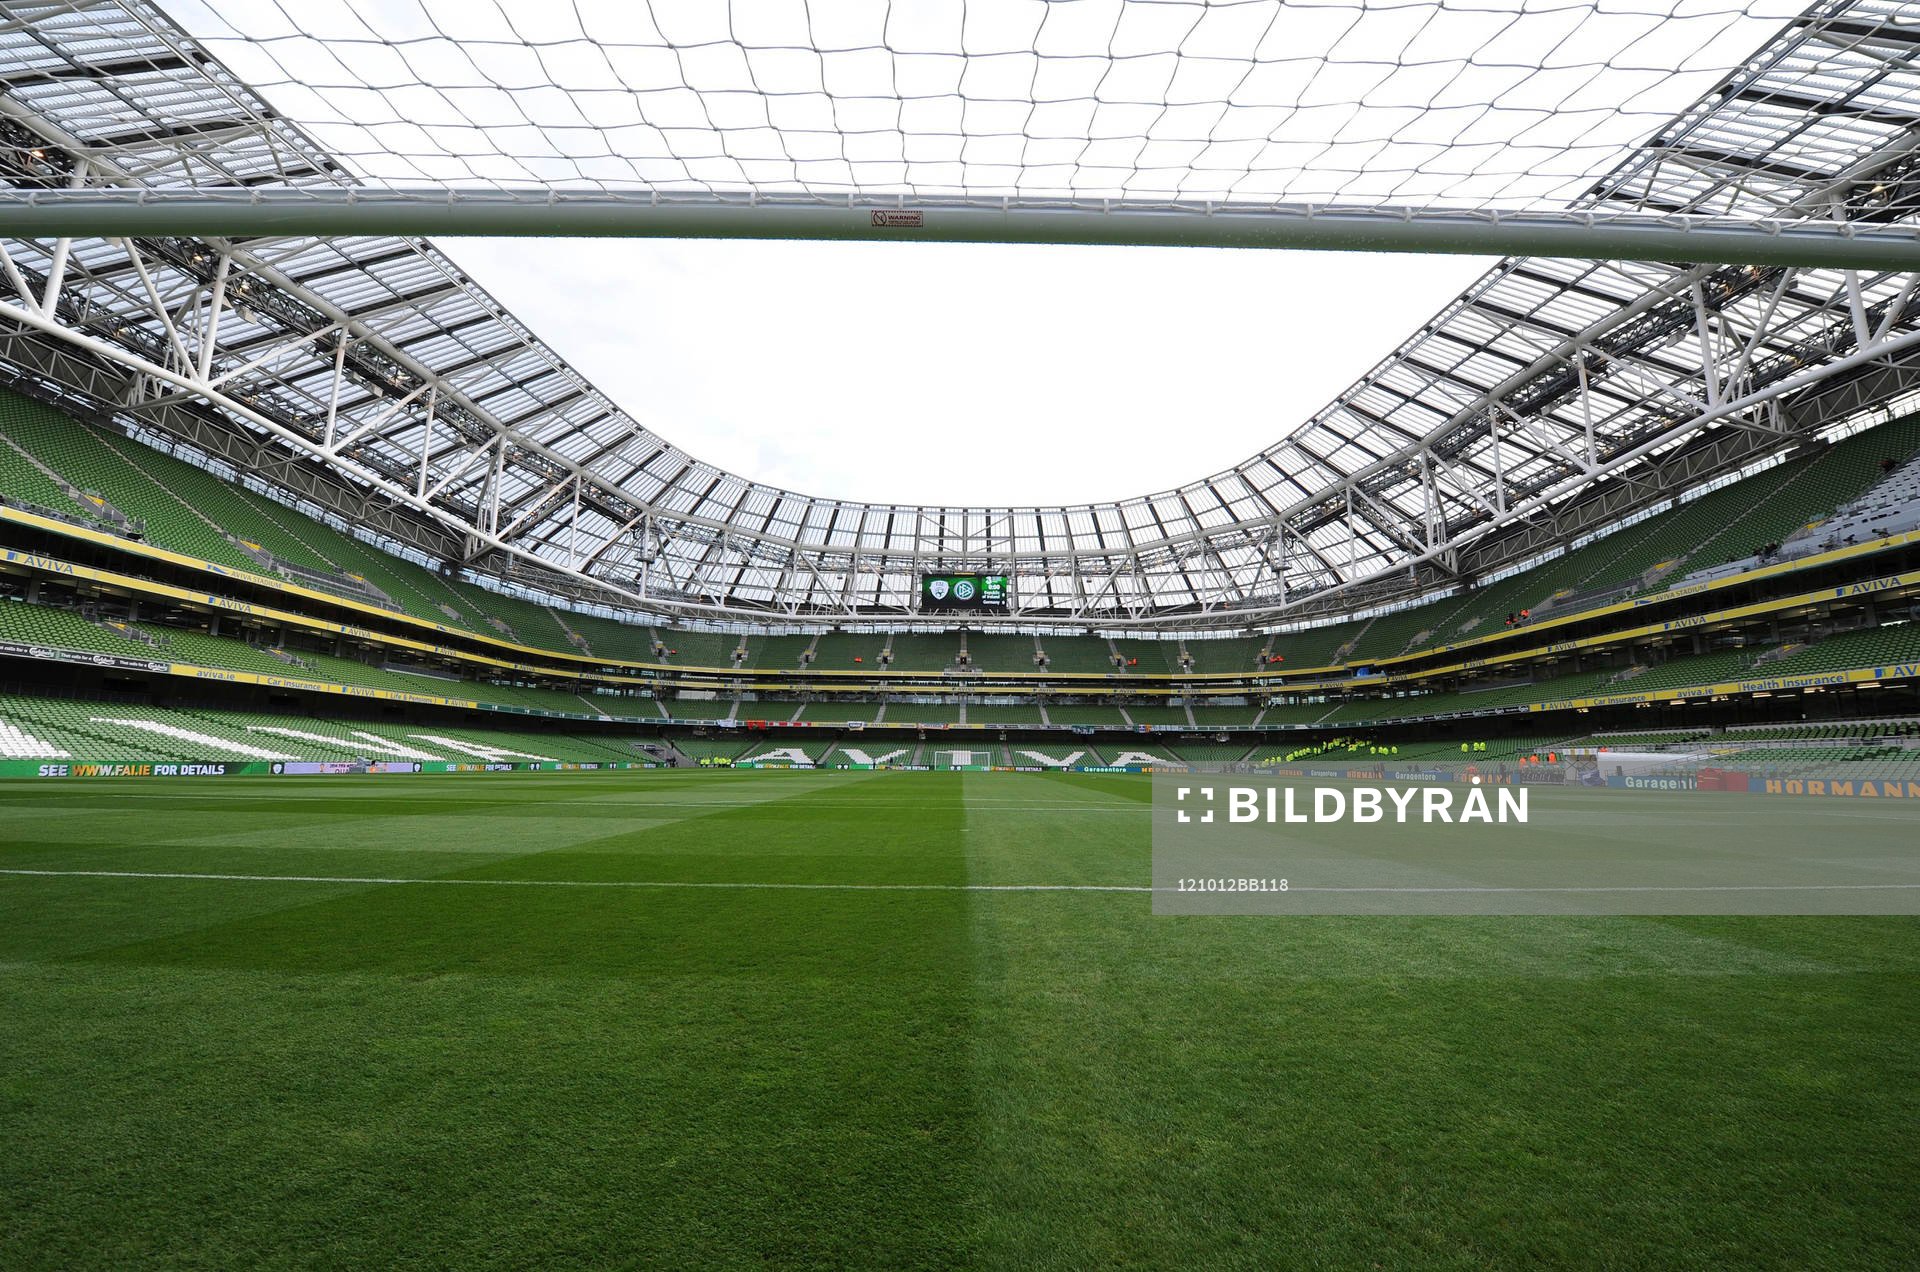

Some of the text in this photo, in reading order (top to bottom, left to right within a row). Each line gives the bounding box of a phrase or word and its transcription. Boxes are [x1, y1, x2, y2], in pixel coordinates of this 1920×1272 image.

[24, 556, 73, 574] AVIVA
[231, 571, 282, 588] AVIVA STADIUM
[1852, 577, 1901, 594] AVIVA
[1655, 584, 1708, 601] AVIVA STADIUM
[219, 600, 251, 613] AVIVA
[1674, 616, 1707, 629] AVIVA
[350, 627, 372, 639] AVIVA
[29, 648, 55, 657] Carlsberg
[1554, 641, 1577, 652] AVIVA
[93, 655, 116, 665] Carlsberg
[196, 669, 236, 681] aviva.ie
[267, 677, 321, 691] Car Insurance
[1743, 674, 1844, 691] Health Insurance
[350, 687, 375, 697] AVIVA
[1676, 687, 1714, 698] aviva.ie
[1549, 701, 1573, 710] AVIVA
[1593, 694, 1646, 706] Car Insurance
[38, 764, 225, 777] SEE WWW.FAI.IE FOR DETAILS
[446, 764, 457, 772] SEE
[1084, 766, 1127, 774] Garagentore
[1395, 771, 1437, 782] Garagentore
[1765, 778, 1920, 798] HÖRMANN
